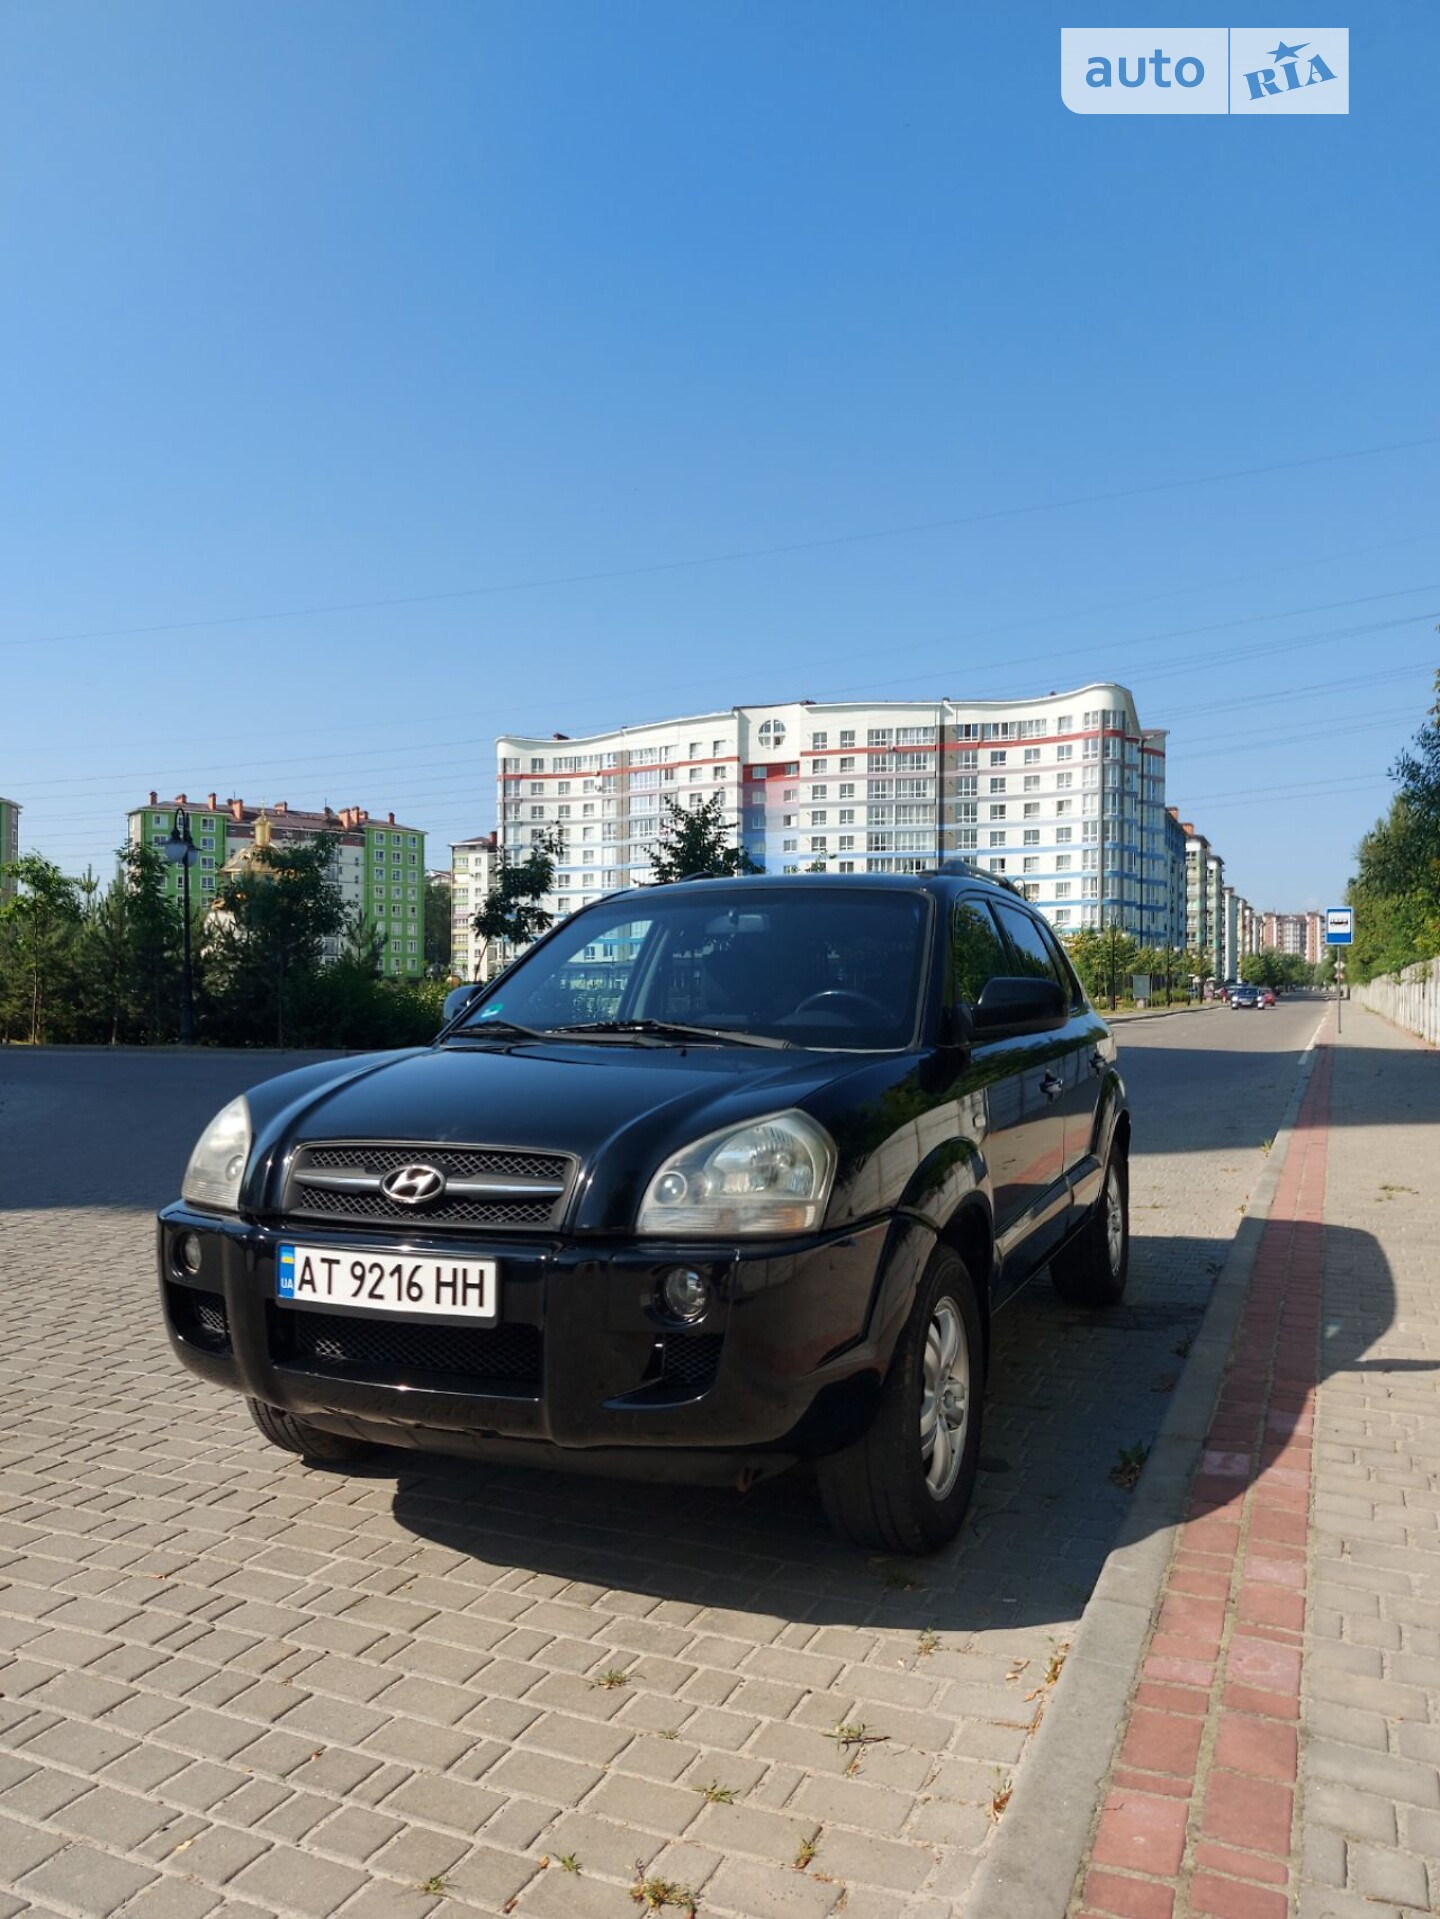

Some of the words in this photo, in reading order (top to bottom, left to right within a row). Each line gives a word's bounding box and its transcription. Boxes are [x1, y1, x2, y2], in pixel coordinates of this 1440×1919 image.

[281, 1278, 293, 1288] UA
[298, 1256, 340, 1294] AT
[350, 1261, 423, 1302] 9216
[435, 1267, 484, 1307] HH
